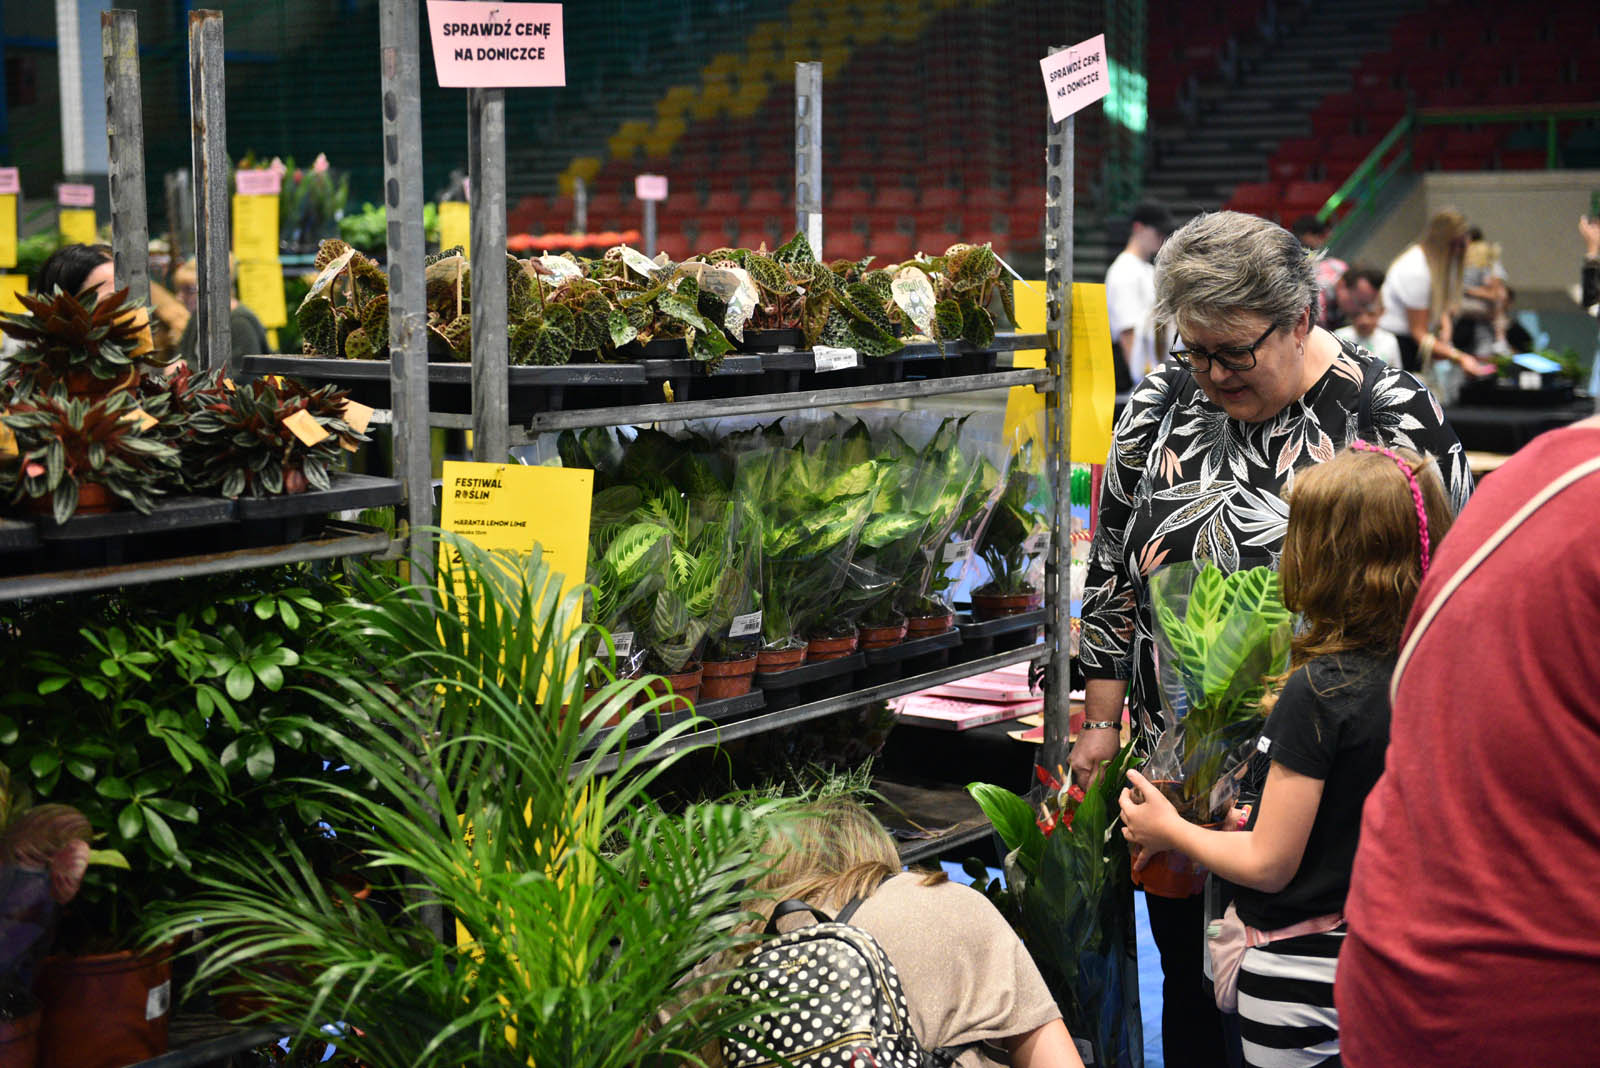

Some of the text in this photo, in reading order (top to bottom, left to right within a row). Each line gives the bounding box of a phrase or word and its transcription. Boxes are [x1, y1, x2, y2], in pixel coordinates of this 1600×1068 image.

[443, 18, 551, 39] SPRAWDŹ CENĘ
[454, 47, 546, 61] NA DONICZCE
[1057, 71, 1100, 99] NA DONICZCE
[455, 478, 502, 488] FESTIWAL
[454, 519, 527, 528] MARANTA LEMON LIME
